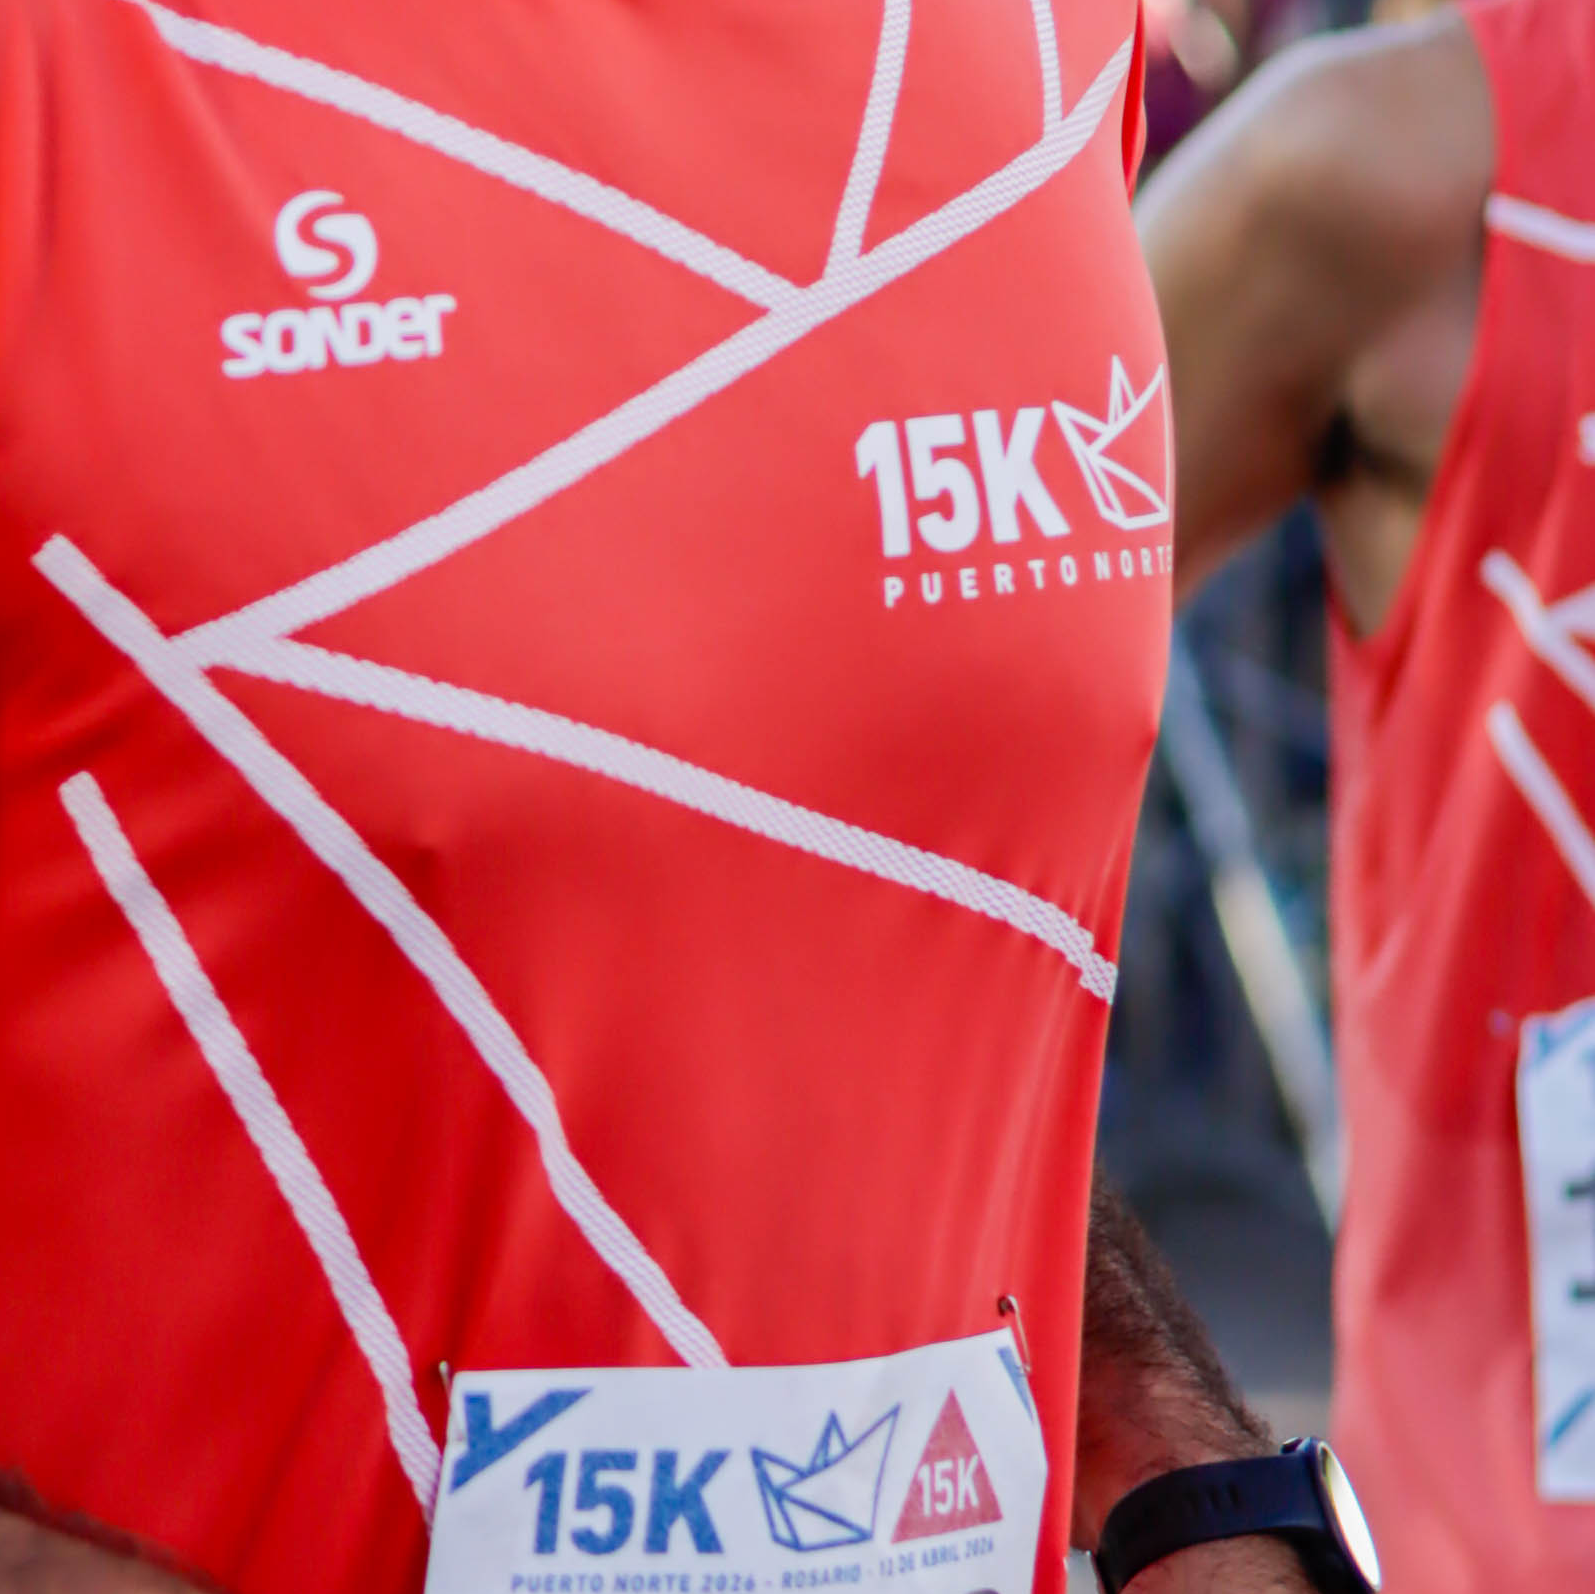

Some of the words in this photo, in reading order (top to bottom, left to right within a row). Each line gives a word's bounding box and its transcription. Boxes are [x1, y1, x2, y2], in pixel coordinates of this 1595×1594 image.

[855, 407, 1070, 558] 15K
[884, 555, 1078, 609] PUERTO
[524, 1449, 731, 1555] 15K
[917, 1453, 980, 1518] 15K
[510, 1572, 605, 1593] PUERTO
[614, 1572, 691, 1593] NORTE
[781, 1563, 862, 1589] ROSARIO
